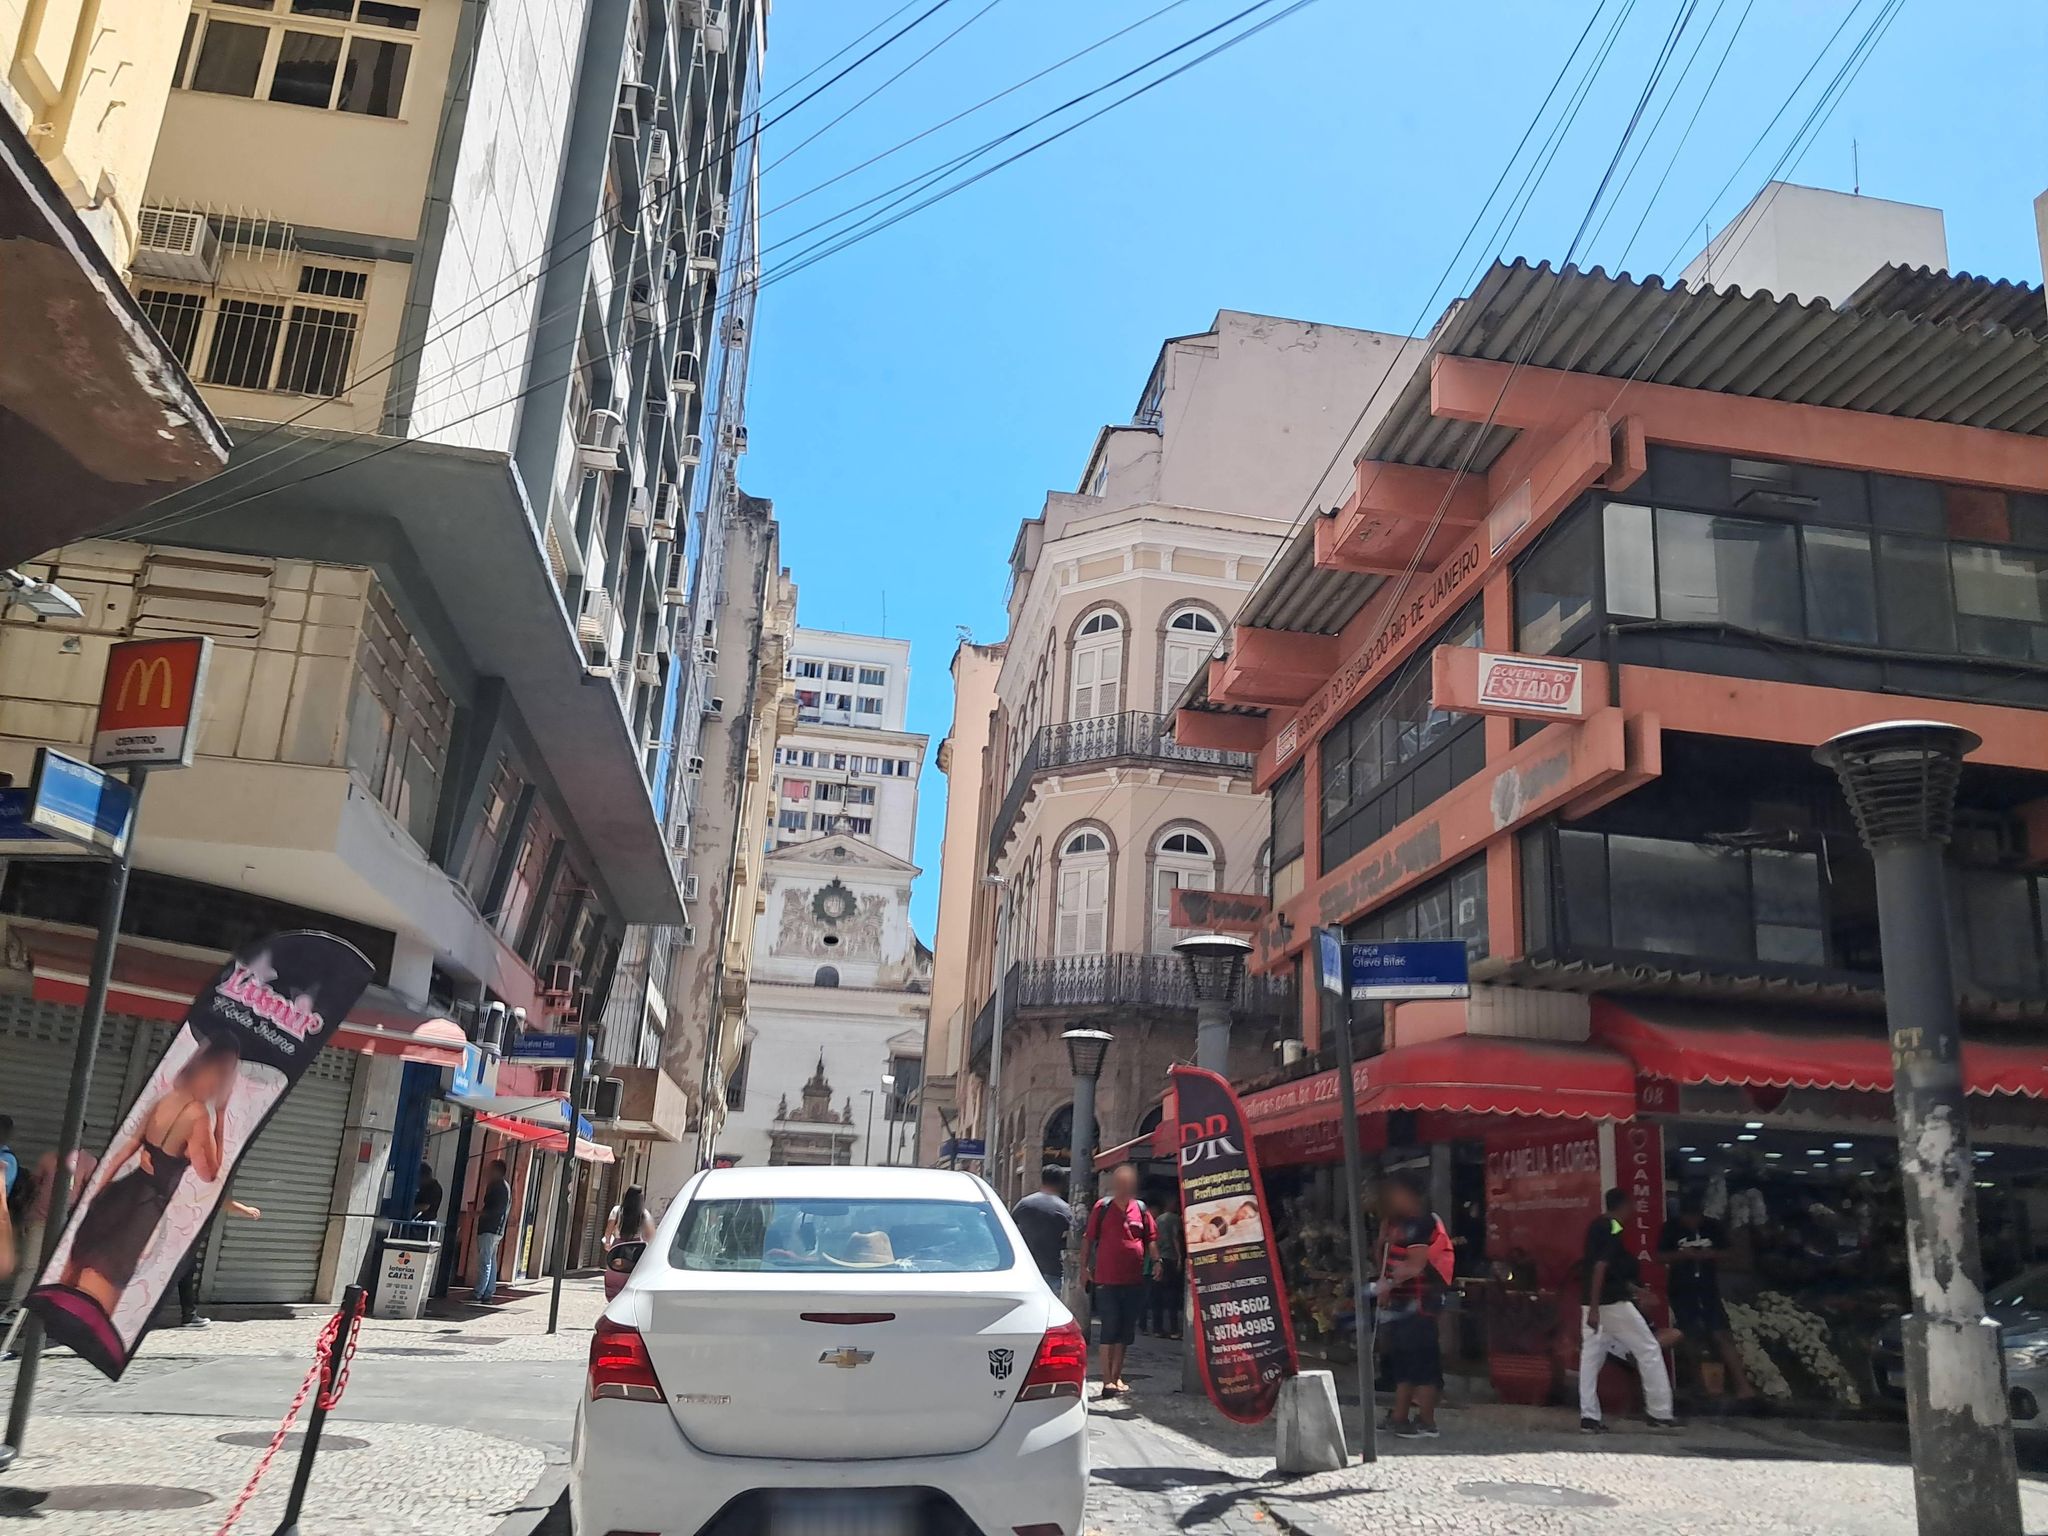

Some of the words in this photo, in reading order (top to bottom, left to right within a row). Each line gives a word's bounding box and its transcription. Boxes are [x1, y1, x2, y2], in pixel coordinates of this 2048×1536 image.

[1390, 613, 1406, 646] RIO
[1411, 594, 1425, 627] DE
[1429, 543, 1479, 609] JANEIRO
[1494, 666, 1548, 680] GOVERNO
[1554, 673, 1571, 683] DO
[1487, 676, 1566, 701] ESTADO
[114, 735, 157, 746] CENTRO
[1352, 944, 1378, 957] Praça
[1353, 955, 1381, 968] Olavo
[1383, 954, 1406, 967] Bilac
[1642, 1086, 1664, 1105] 08
[1180, 1113, 1243, 1166] DR
[1552, 1138, 1599, 1174] FLORES
[388, 1271, 414, 1281] CAIXA
[389, 1265, 415, 1273] loterias
[1210, 1295, 1271, 1320] 98796-6602
[1214, 1316, 1275, 1341] 98784-9985
[1263, 1367, 1280, 1381] 18+
